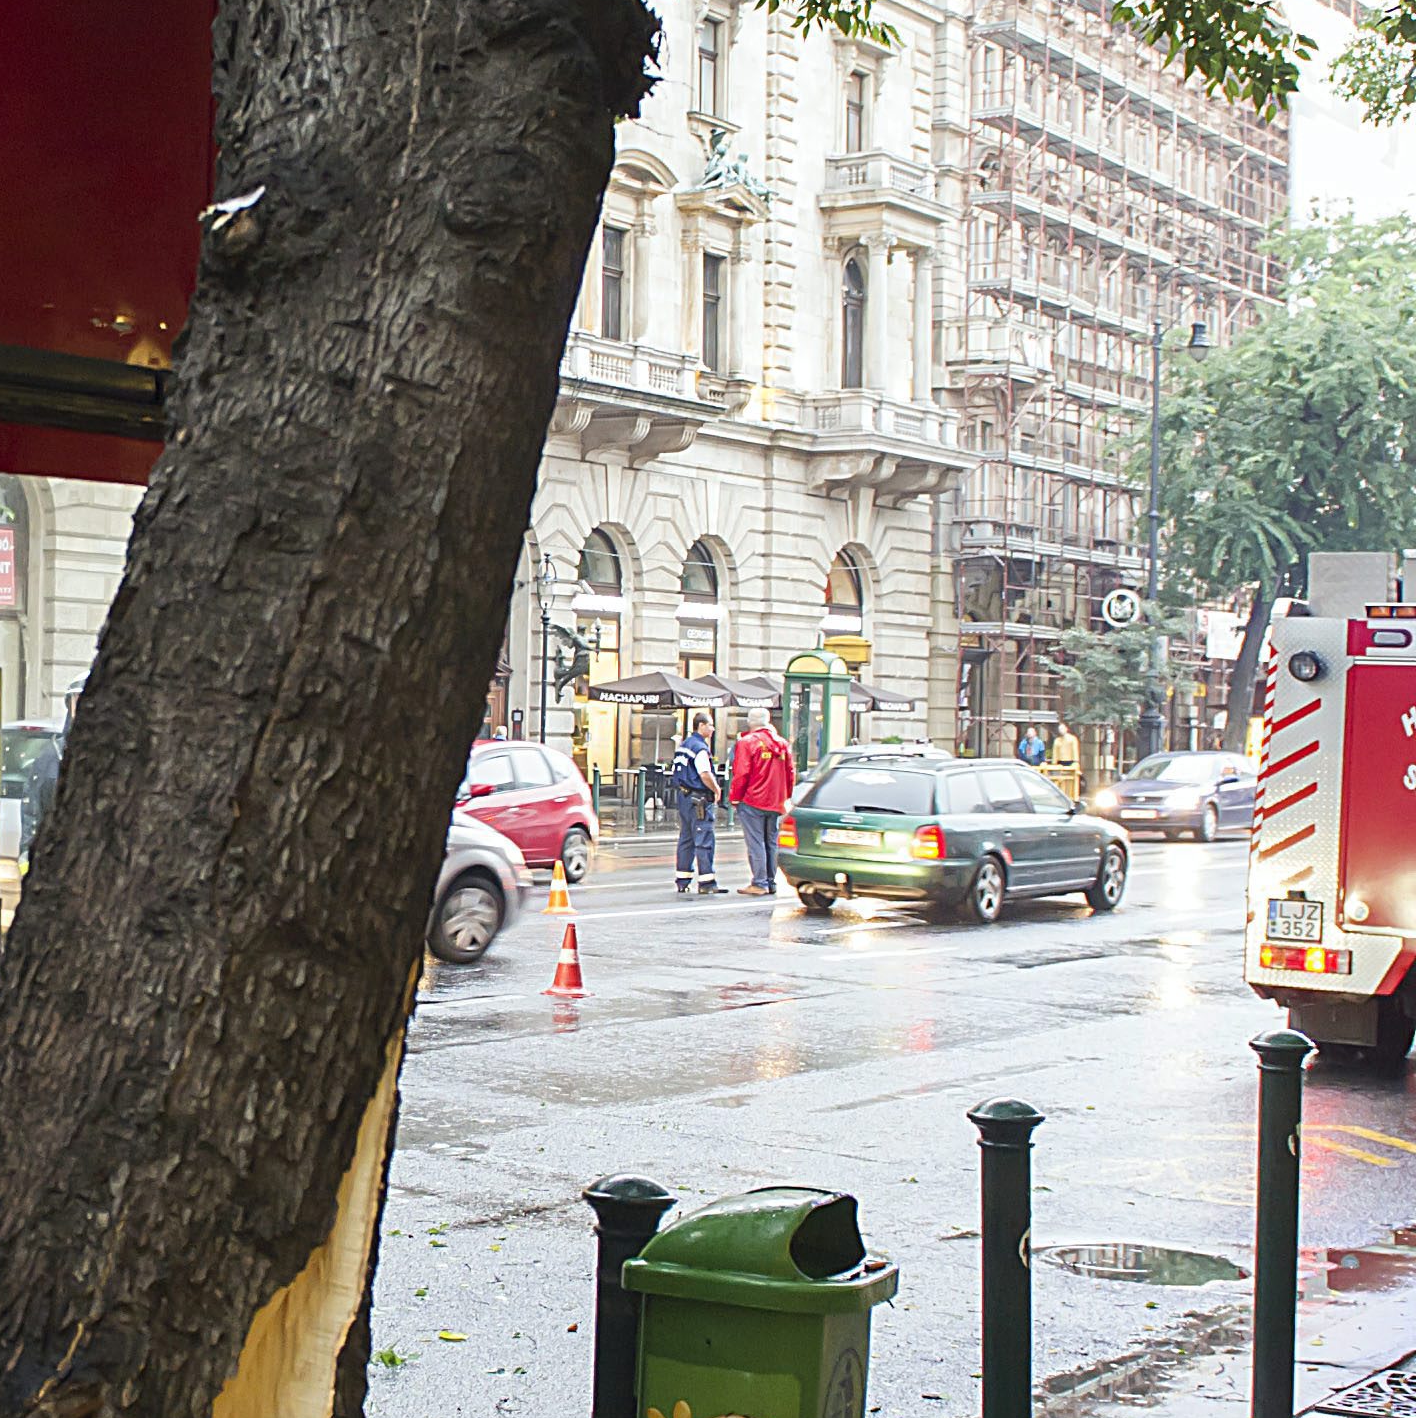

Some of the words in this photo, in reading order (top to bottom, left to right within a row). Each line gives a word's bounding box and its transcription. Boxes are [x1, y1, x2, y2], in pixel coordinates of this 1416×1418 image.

[599, 692, 660, 704] HACHAPURI
[1279, 903, 1319, 921] LJZ
[1282, 920, 1315, 938] 352
